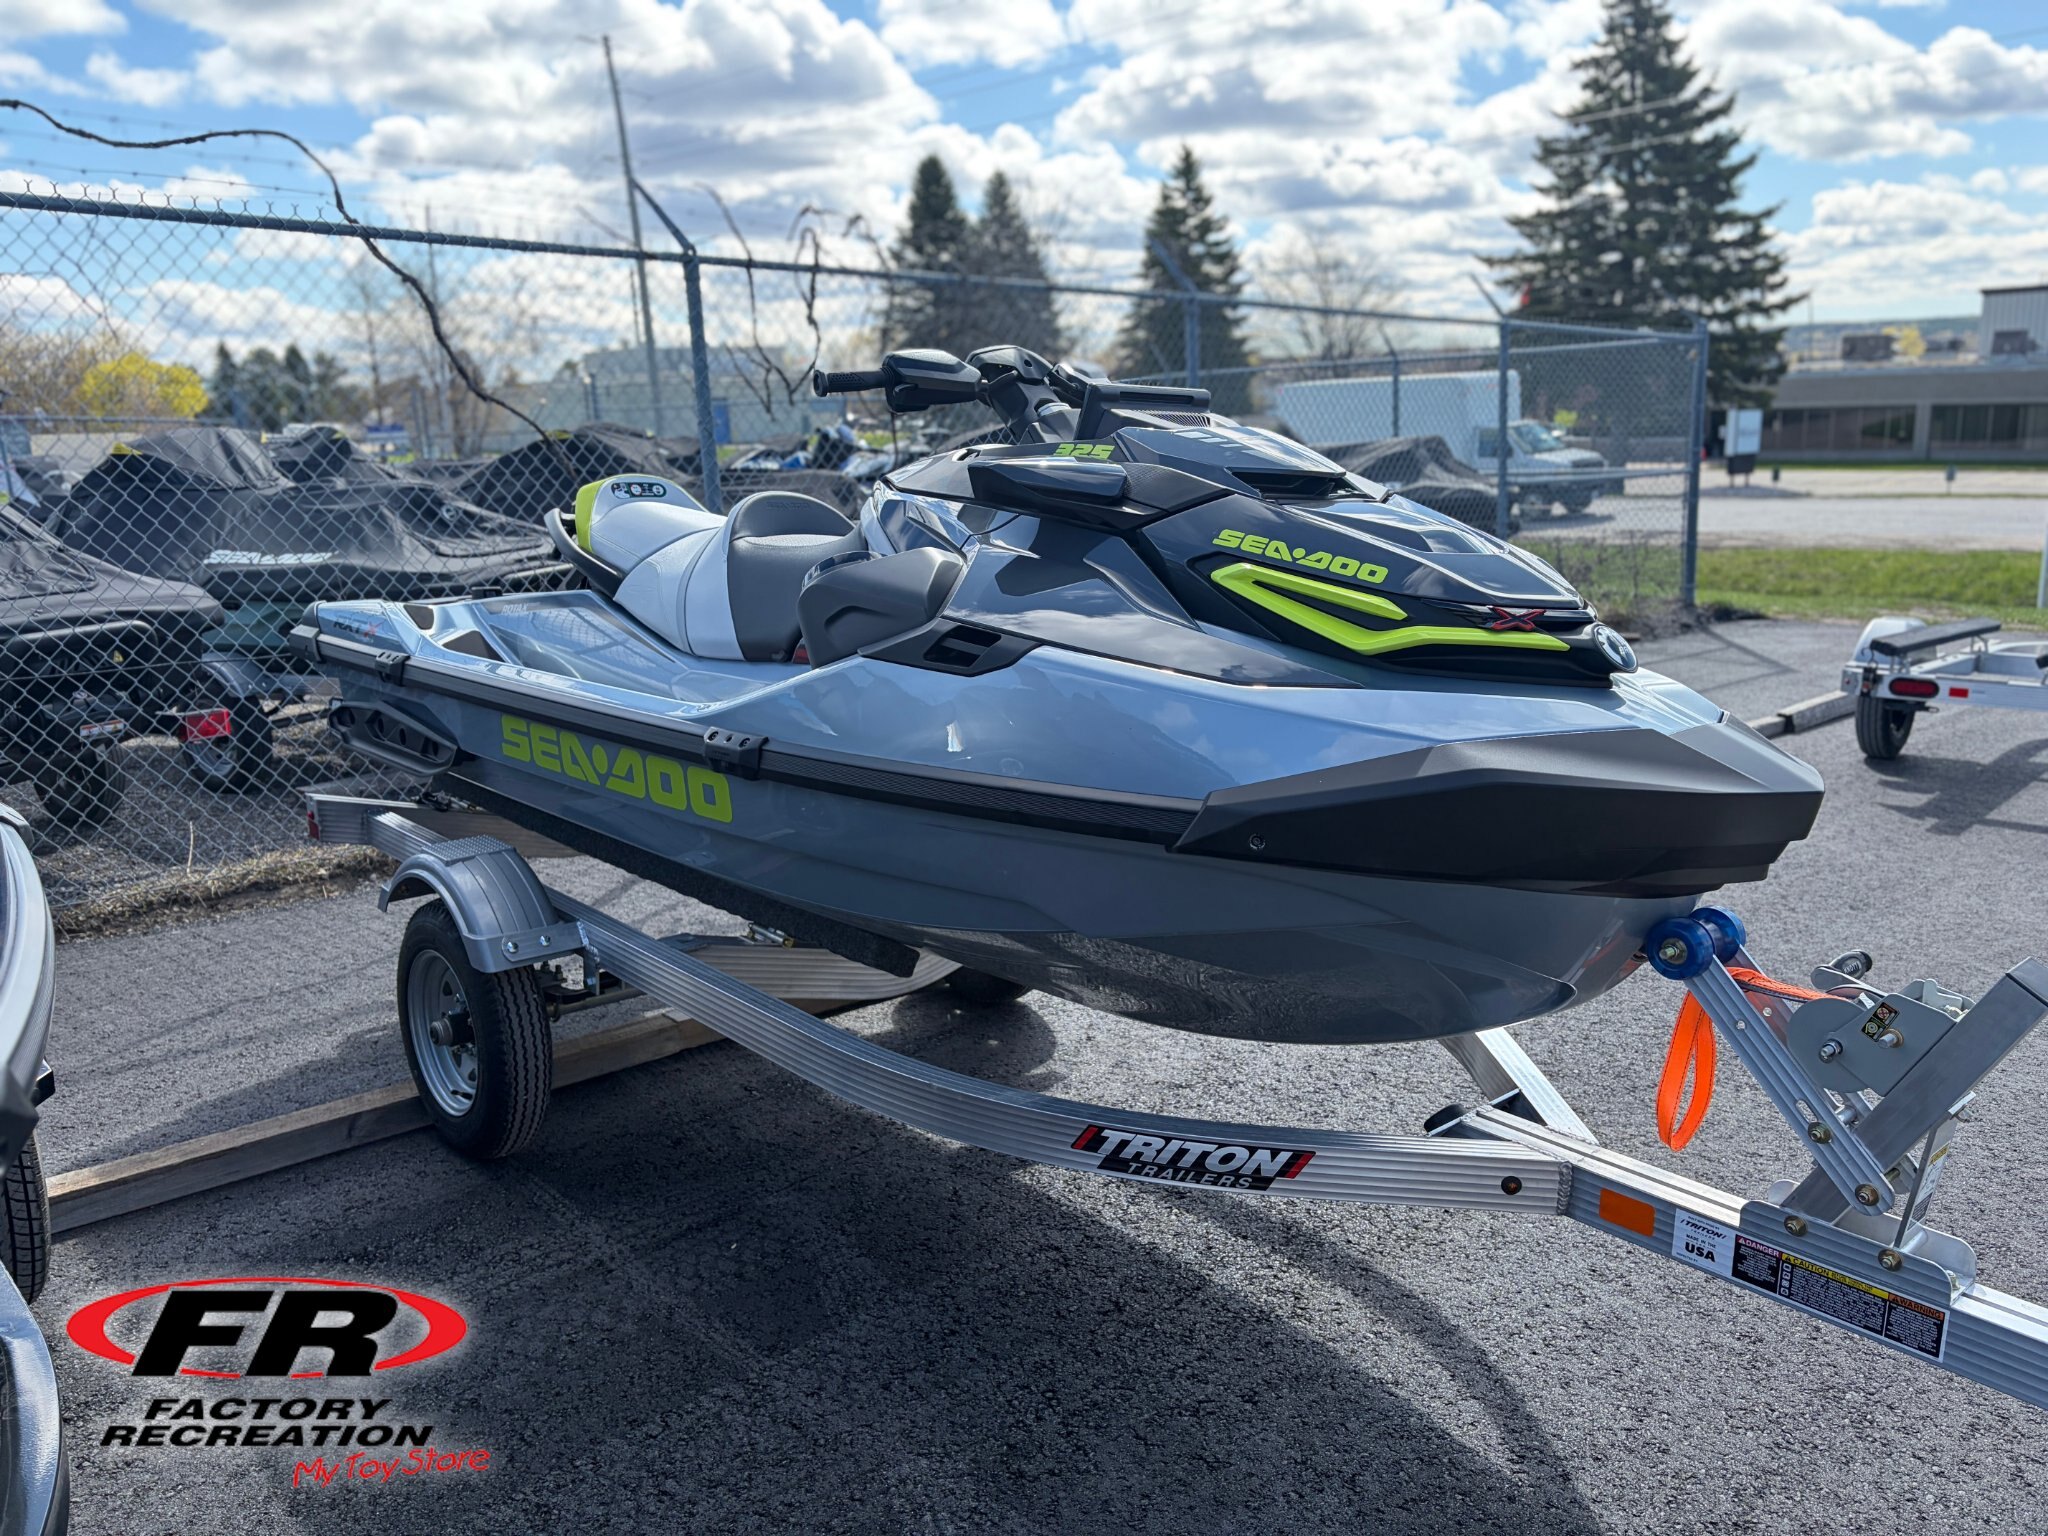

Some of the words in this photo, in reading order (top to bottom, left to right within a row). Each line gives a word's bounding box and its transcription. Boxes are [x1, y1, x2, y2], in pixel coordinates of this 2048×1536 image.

[1053, 443, 1115, 460] 325
[1097, 1128, 1293, 1177] TRITON
[1127, 1162, 1254, 1190] TRAILERS
[1684, 1220, 1723, 1239] TRITON
[1686, 1234, 1699, 1242] MADE
[1684, 1241, 1716, 1263] USA
[1745, 1240, 1780, 1258] DANGER
[1793, 1255, 1830, 1278] CAUTION
[1900, 1298, 1942, 1320] WARNING
